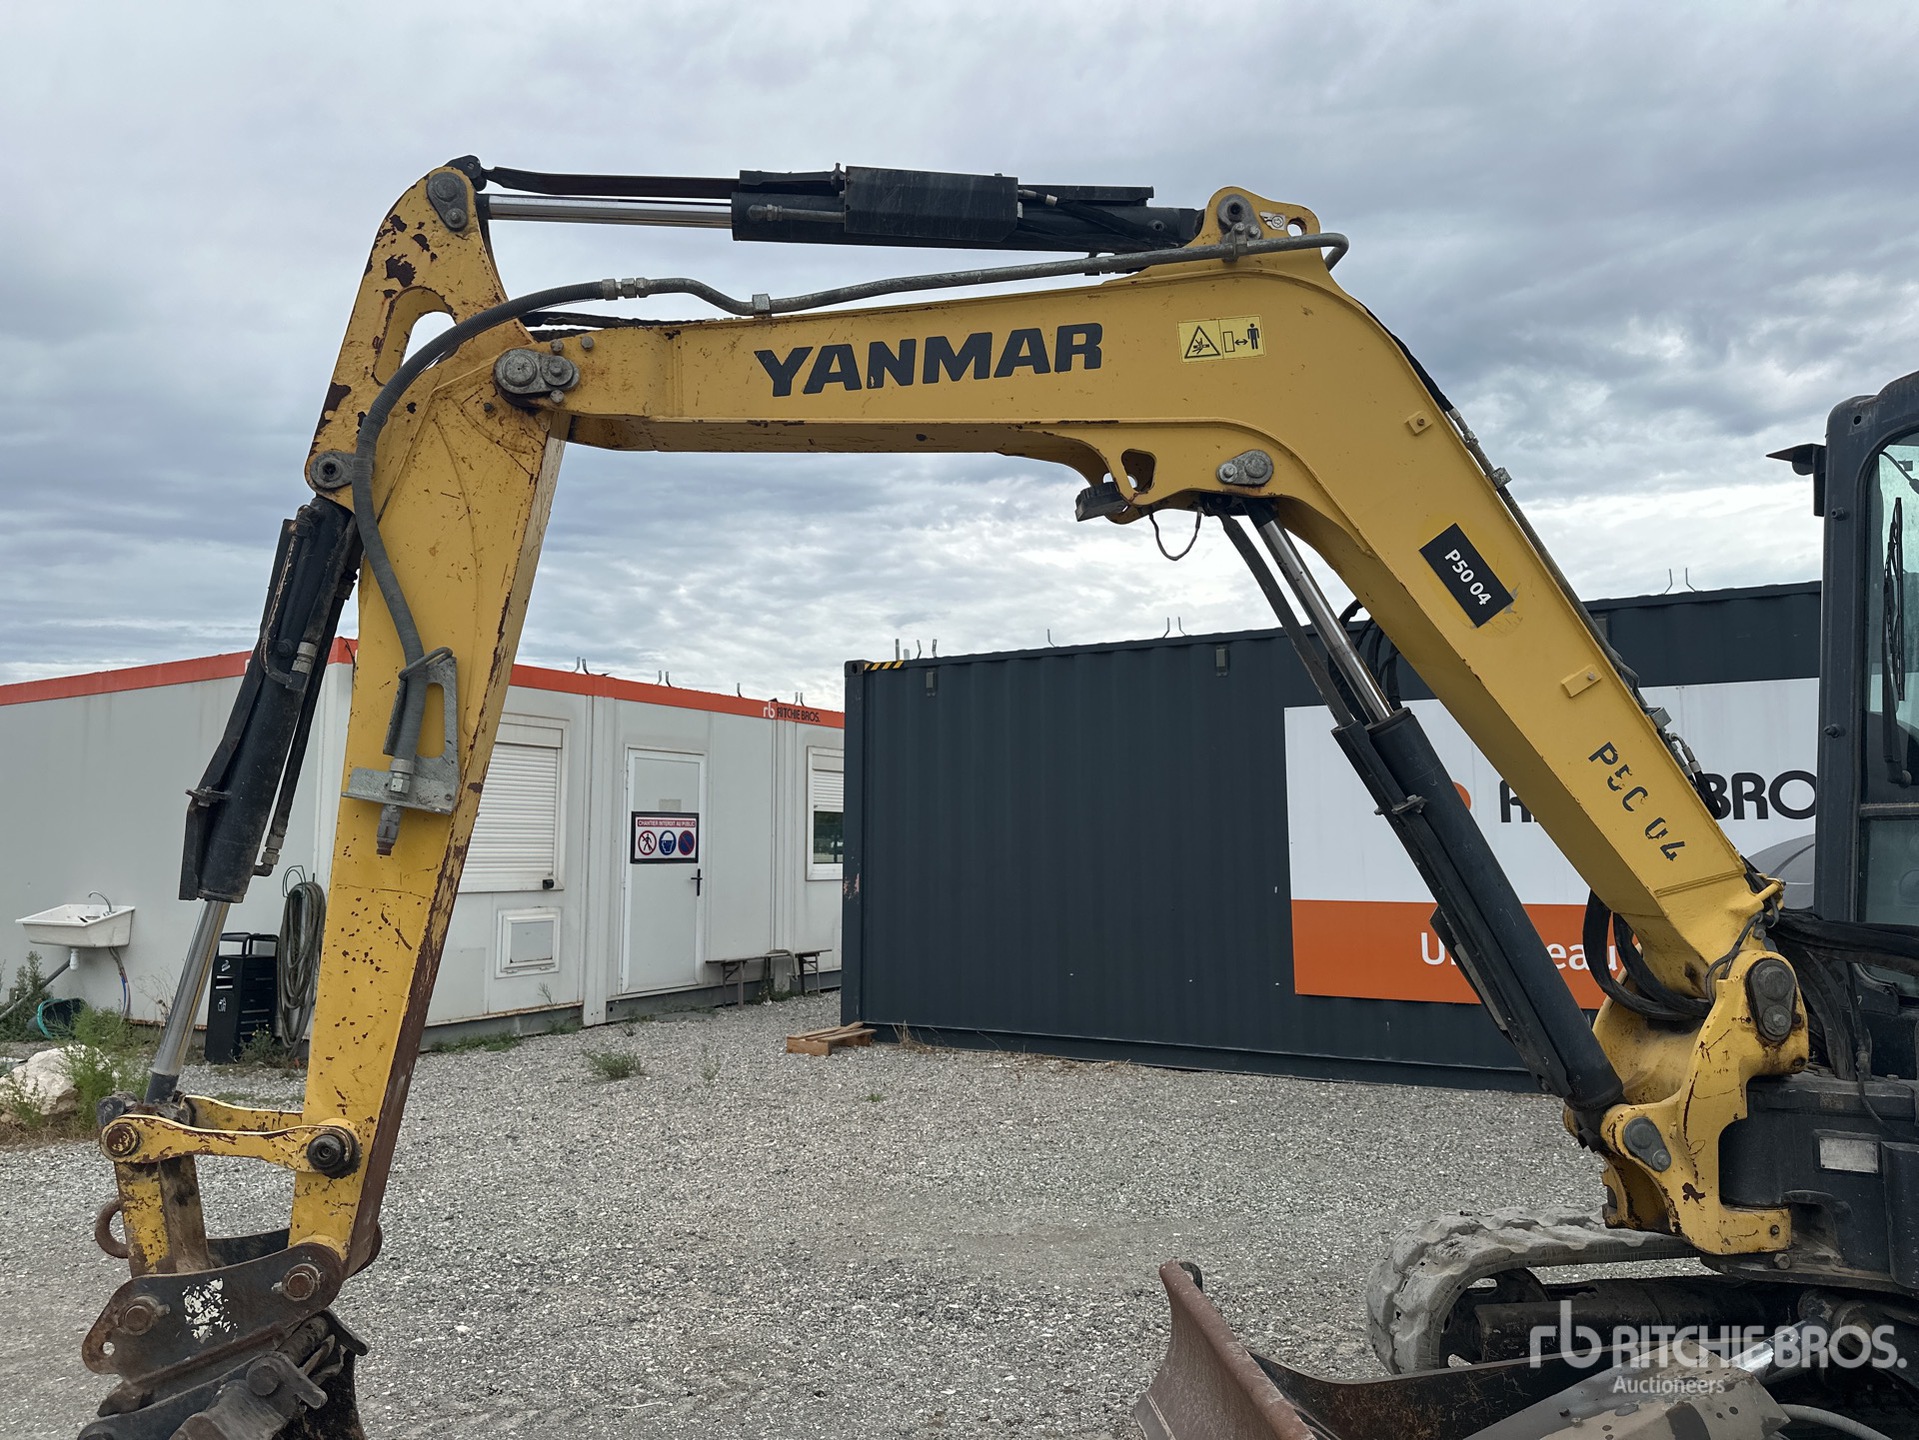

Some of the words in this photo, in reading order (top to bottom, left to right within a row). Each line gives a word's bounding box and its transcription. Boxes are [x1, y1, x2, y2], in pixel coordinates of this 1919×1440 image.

[754, 322, 1103, 397] YANMAR
[1444, 549, 1475, 583] P50
[1469, 582, 1492, 606] 04
[777, 706, 800, 720] RITCHIE
[1702, 770, 1817, 820] BRO
